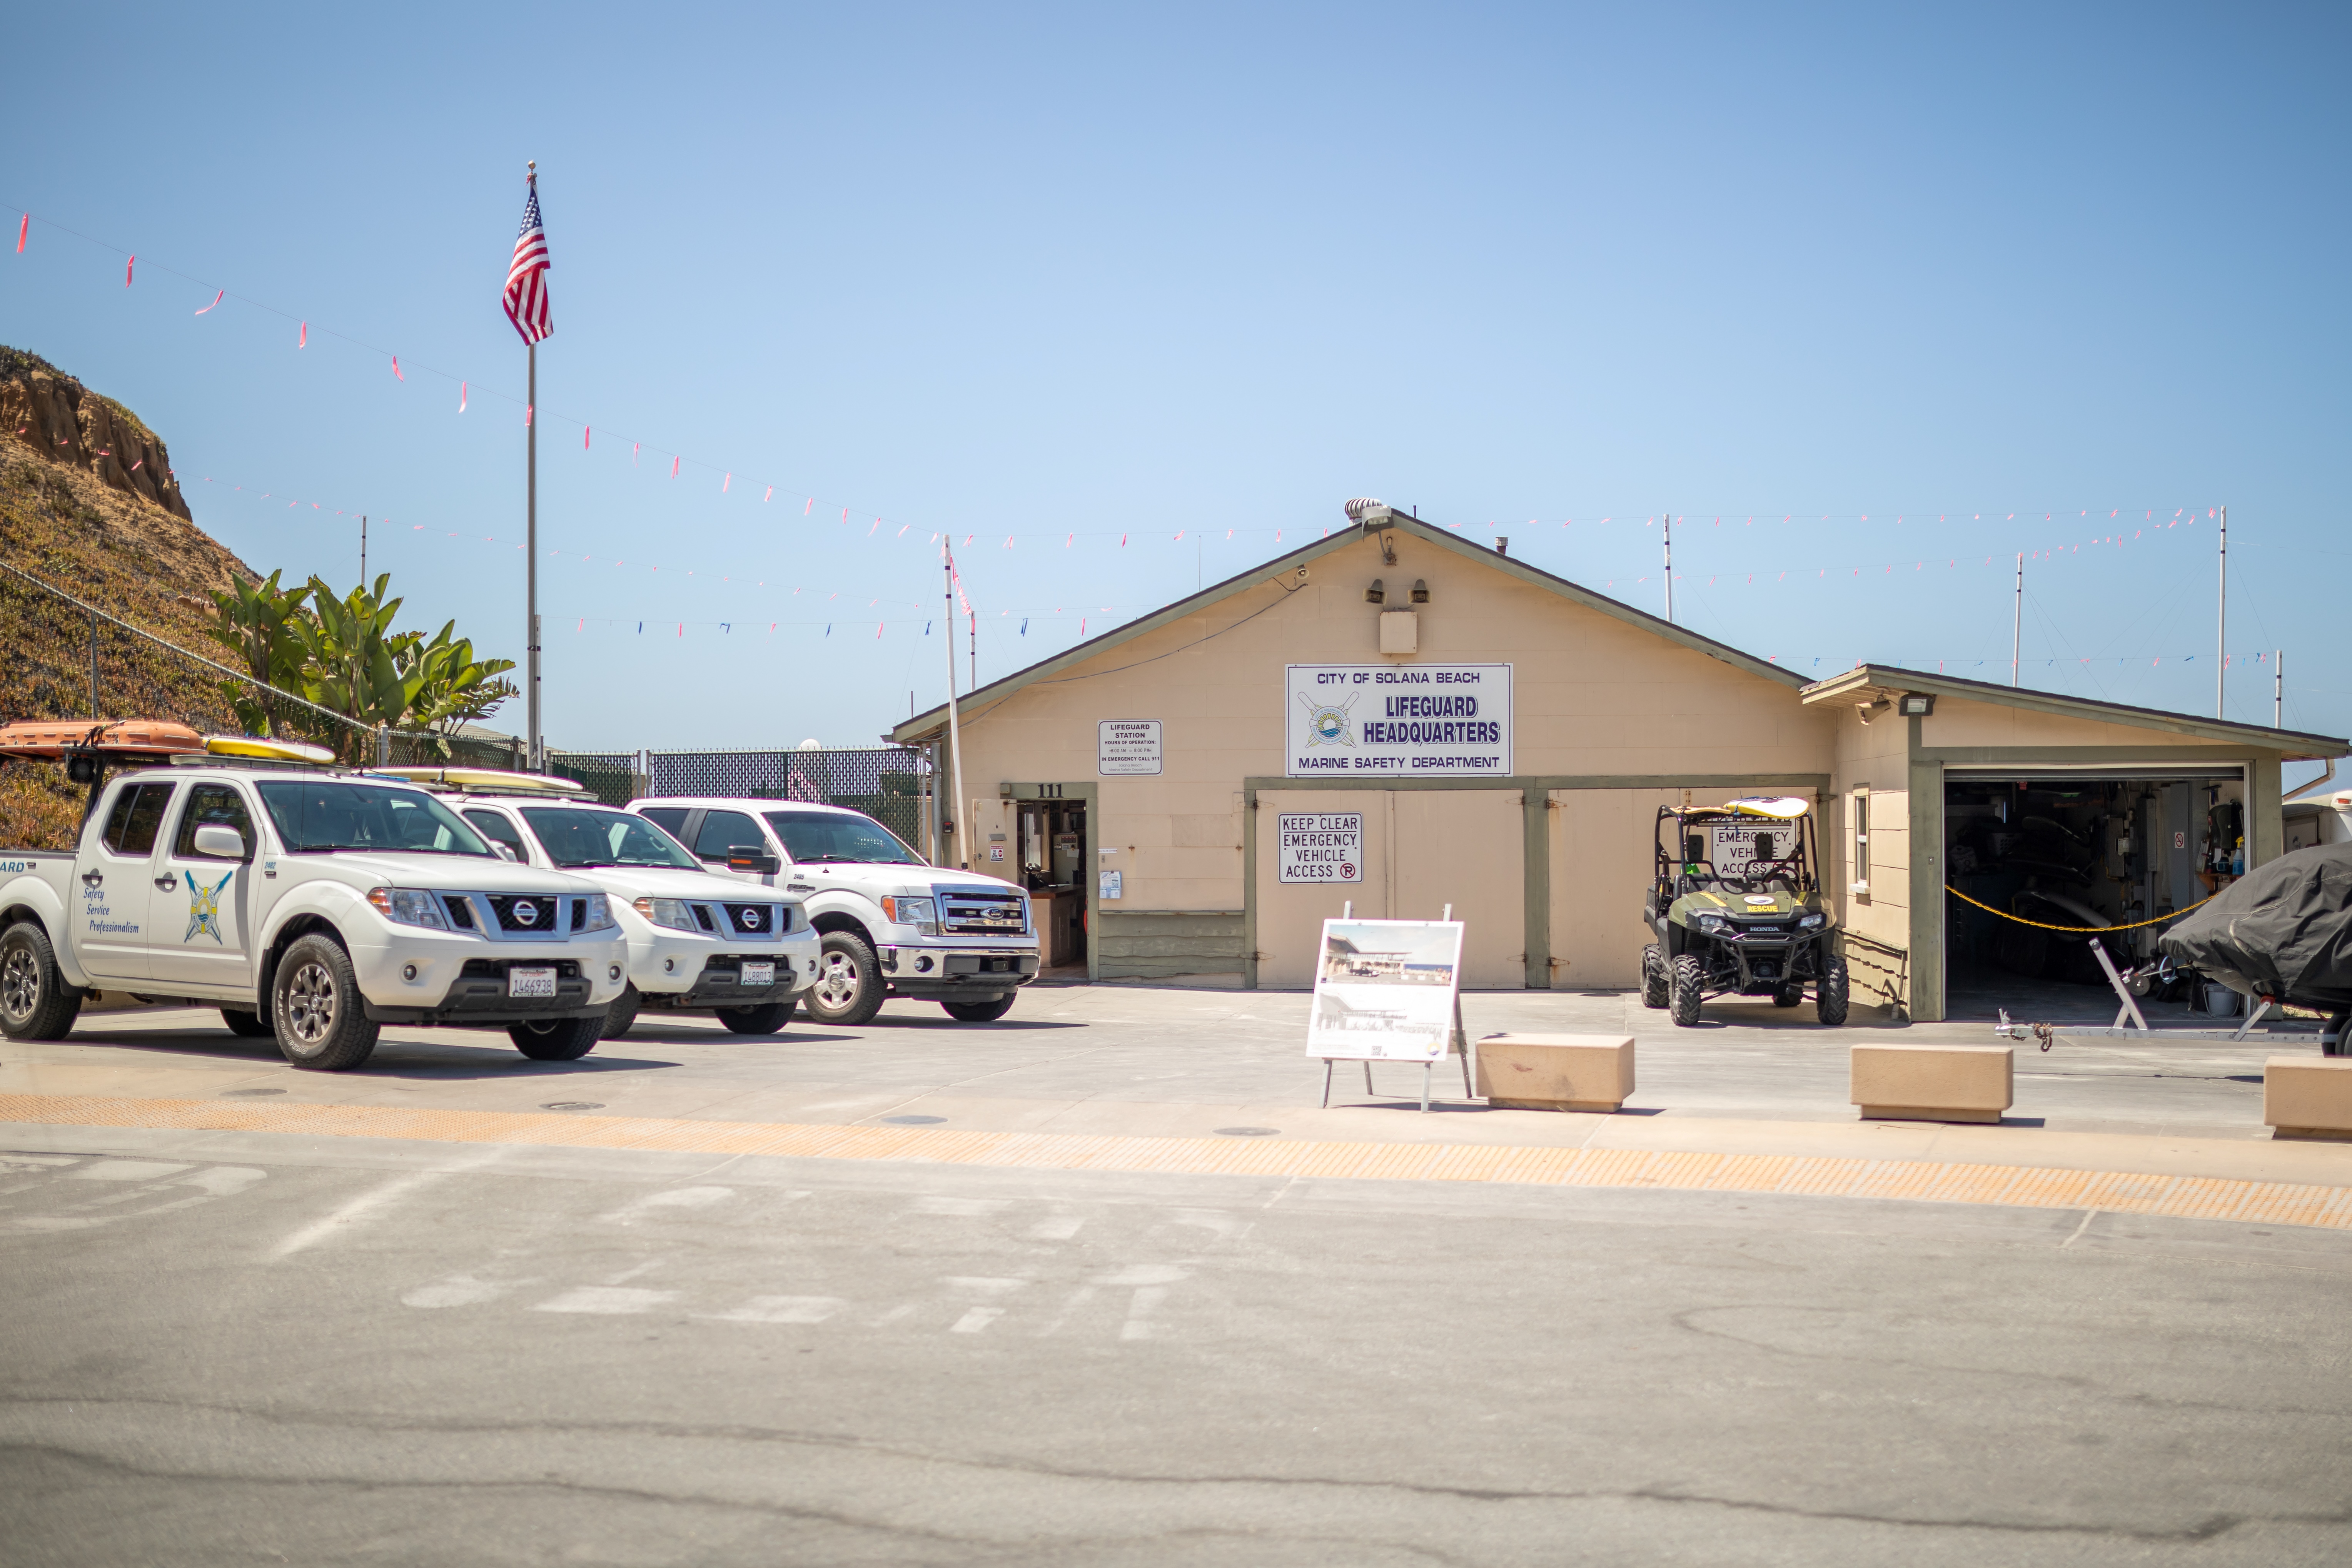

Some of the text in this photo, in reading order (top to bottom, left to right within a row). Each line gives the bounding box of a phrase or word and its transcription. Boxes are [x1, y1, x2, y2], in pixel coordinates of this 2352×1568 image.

[1317, 673, 1480, 684] CITY OF SOLANA BEACH
[1385, 696, 1478, 718] LIFEGUARD
[1336, 710, 1345, 718] BEACH
[1363, 721, 1501, 746] HEADQUARTERS
[1299, 757, 1499, 768] MARINE SAFETY DEPARTMENT
[1038, 783, 1064, 798] 111
[1283, 817, 1357, 830] KEEP CLEAR
[1284, 834, 1357, 847] EMERGENCY
[1719, 832, 1789, 842] EMERGCY
[1296, 849, 1346, 862] VEHICLE
[1730, 847, 1778, 858] VEHIE
[1286, 865, 1333, 877] ACCESS
[83, 887, 105, 902] Safety
[87, 904, 110, 915] Service
[89, 920, 139, 934] Professionalism
[744, 972, 771, 982] 1488013
[514, 980, 551, 992] 1466938
